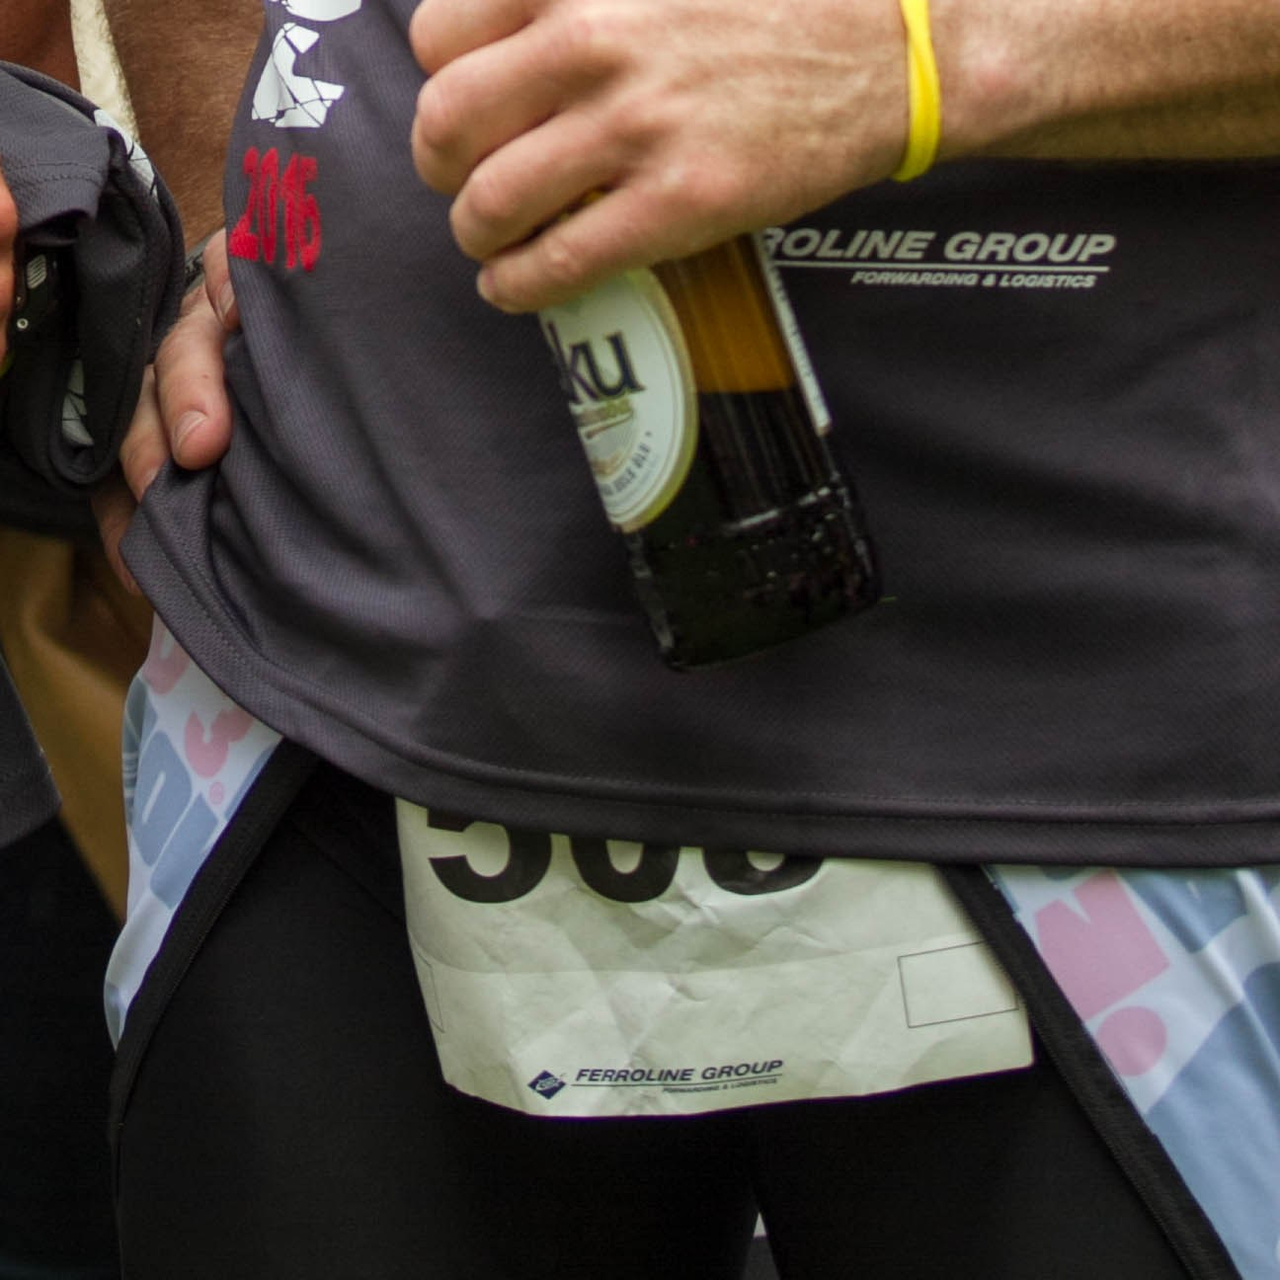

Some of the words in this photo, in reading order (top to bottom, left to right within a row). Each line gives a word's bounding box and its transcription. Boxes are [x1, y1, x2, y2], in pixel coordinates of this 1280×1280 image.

[228, 146, 322, 272] 2016
[943, 231, 1116, 262] GROUP
[851, 271, 980, 286] FORWARDING
[982, 273, 996, 287] &
[999, 273, 1097, 288] LOGISTICS
[574, 1065, 697, 1085] FERROLINE
[700, 1058, 784, 1081] GROUP
